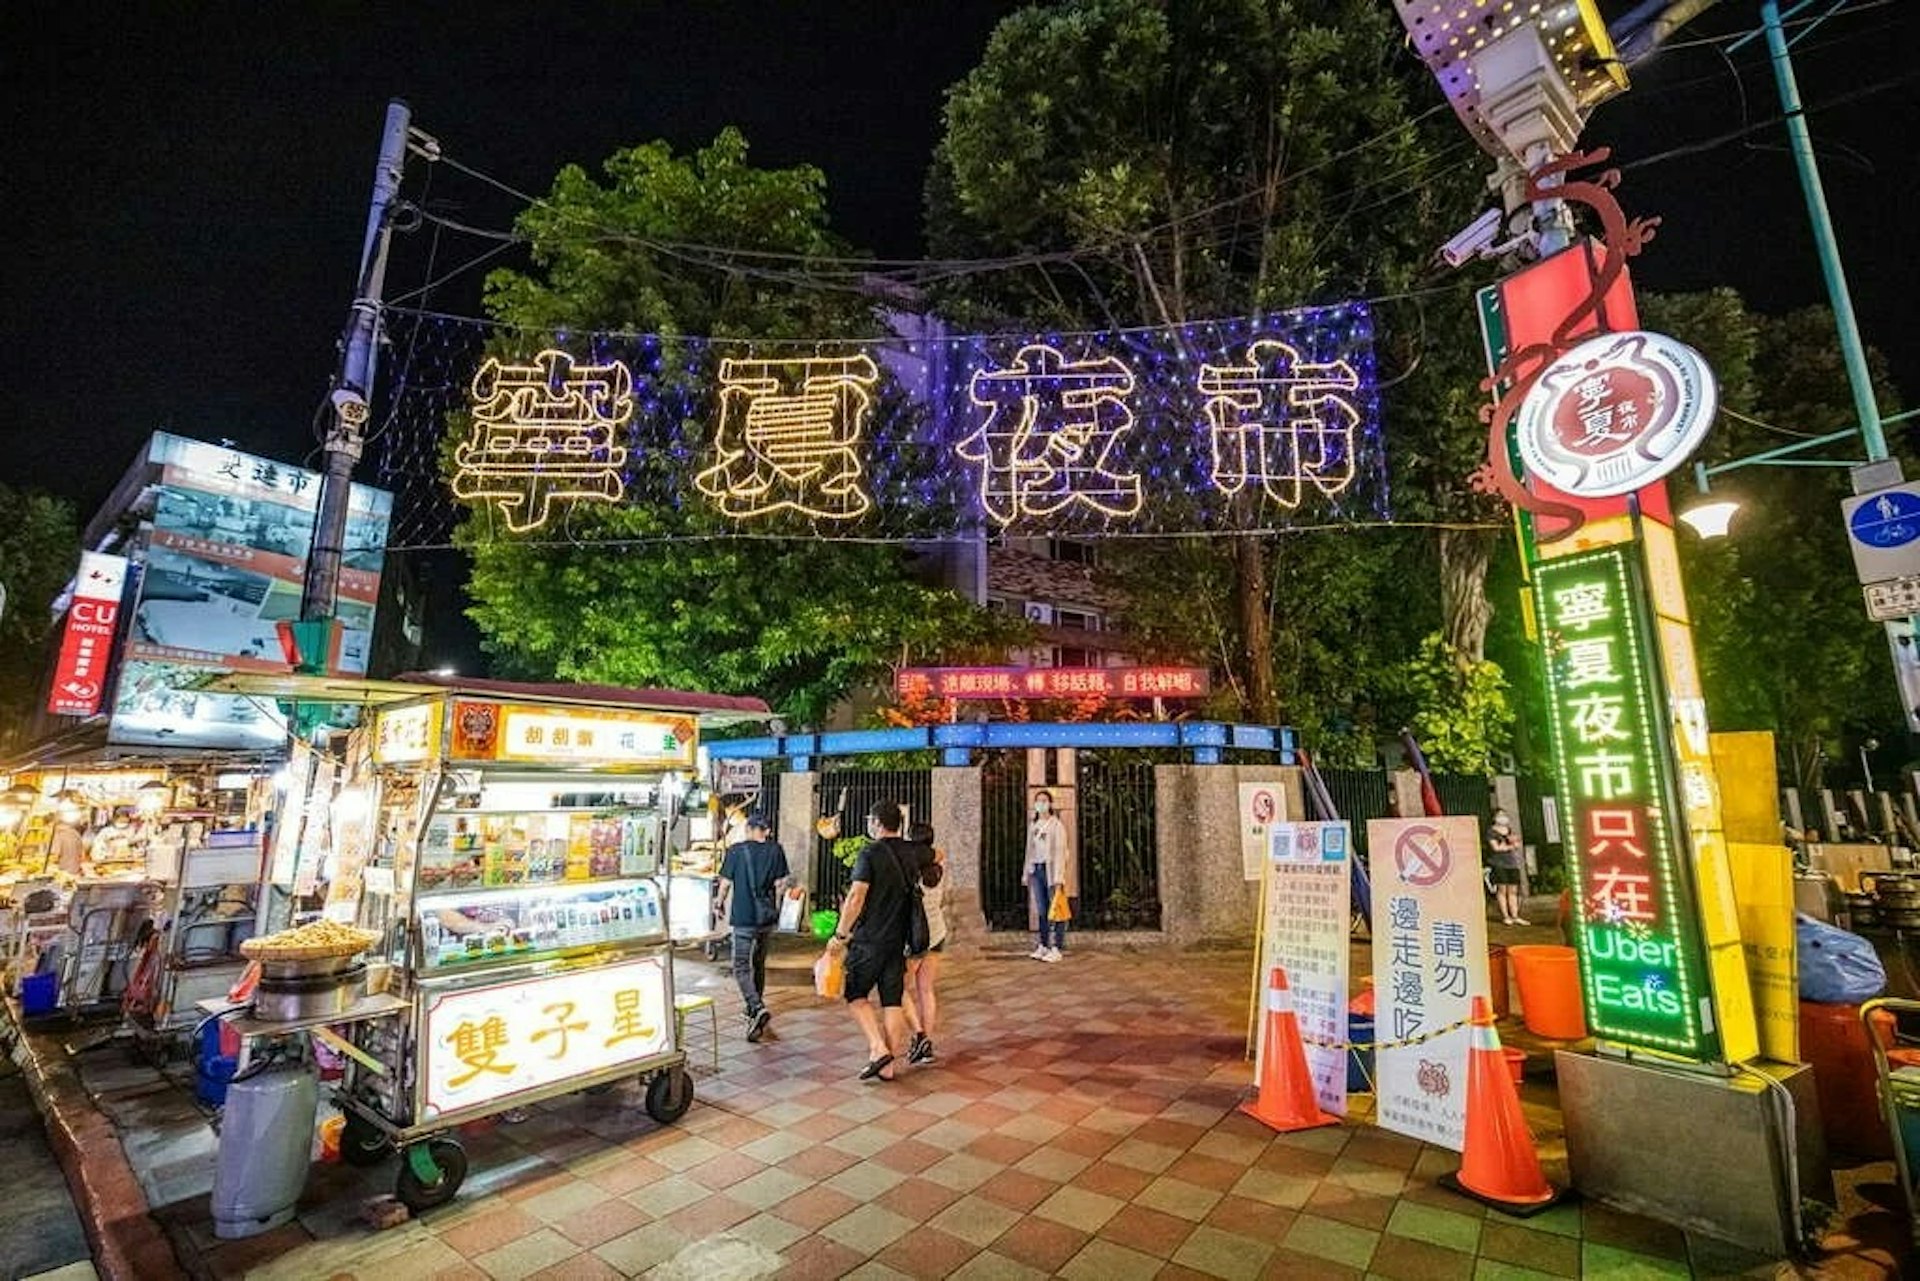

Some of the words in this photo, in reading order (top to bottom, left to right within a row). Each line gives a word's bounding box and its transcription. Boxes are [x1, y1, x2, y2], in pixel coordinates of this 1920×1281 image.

[452, 340, 1360, 531] 寧夏夜市
[71, 623, 113, 636] HOTEL
[72, 603, 117, 624] CU
[1389, 897, 1426, 1040] 邊走邊吃
[1431, 921, 1468, 999] 請勿
[1587, 926, 1677, 967] Uber
[1594, 974, 1681, 1014] Eats
[446, 987, 655, 1088] 雙子星
